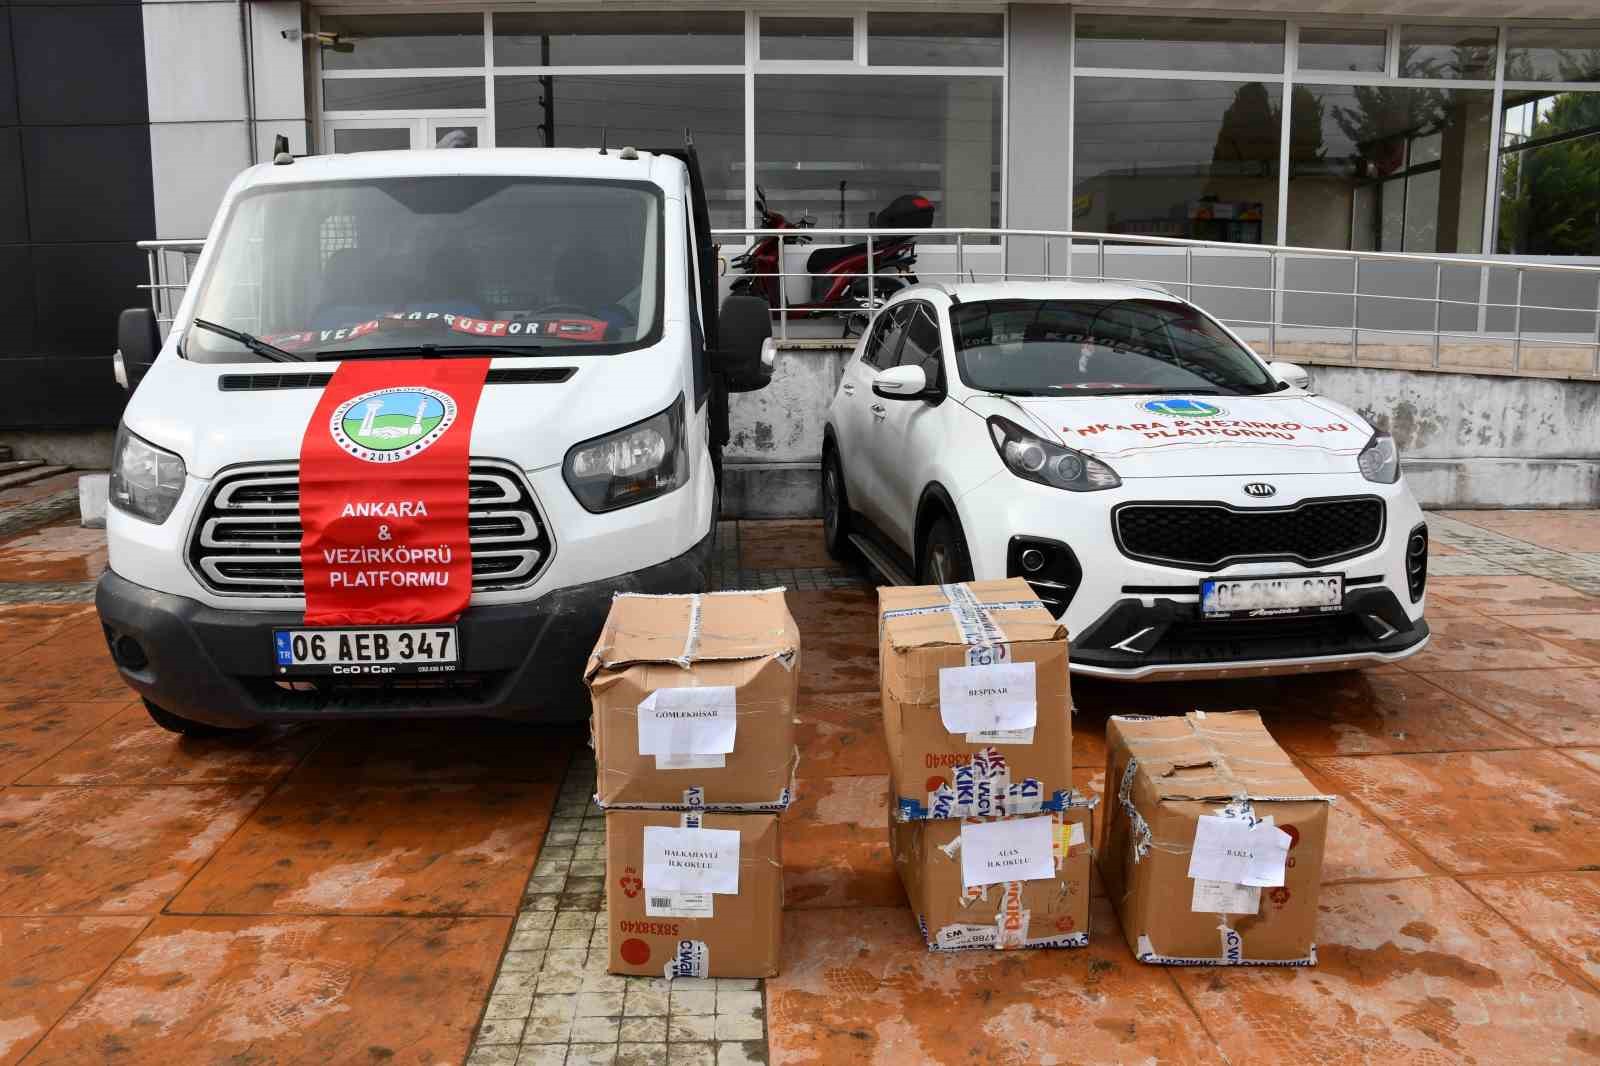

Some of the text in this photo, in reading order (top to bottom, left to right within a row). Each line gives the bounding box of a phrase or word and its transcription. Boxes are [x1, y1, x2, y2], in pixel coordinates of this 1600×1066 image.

[369, 452, 400, 461] 2015
[1248, 484, 1274, 494] KIA
[341, 501, 428, 517] ANKARA
[378, 524, 392, 541] &
[323, 544, 451, 564] VEZİRKÖPRÜ
[330, 571, 449, 588] PLATFORMU
[292, 631, 451, 662] 06 AEB 347
[279, 651, 291, 659] TR
